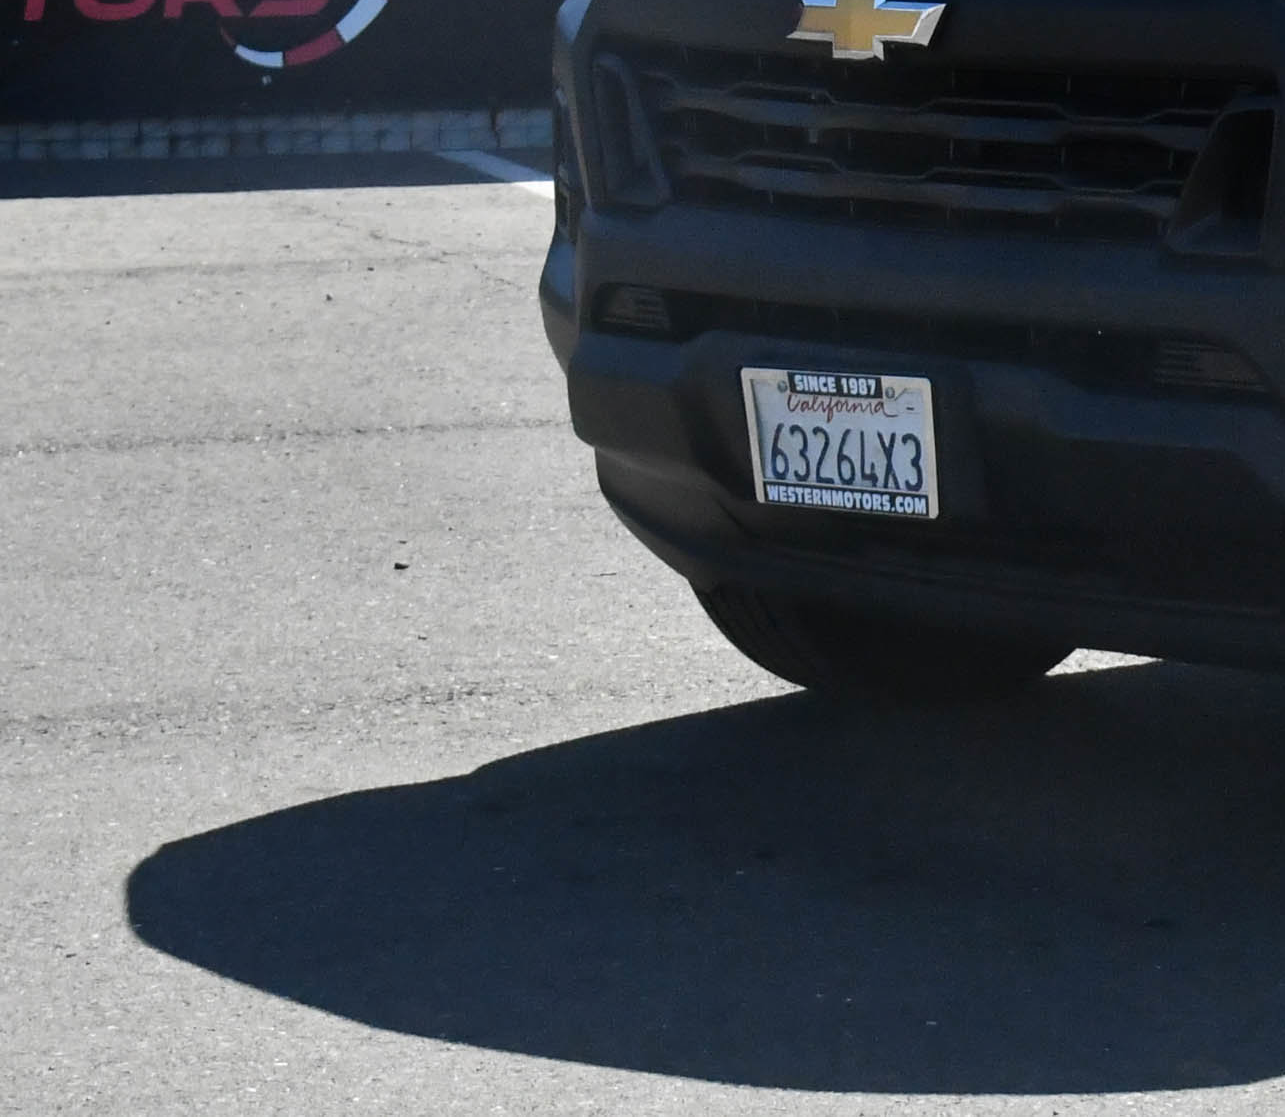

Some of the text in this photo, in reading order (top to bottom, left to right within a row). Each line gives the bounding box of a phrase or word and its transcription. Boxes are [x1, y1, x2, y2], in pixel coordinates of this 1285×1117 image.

[793, 374, 877, 396] SINCE 1987
[787, 394, 898, 424] California
[771, 422, 924, 493] 63264X3
[766, 484, 928, 516] WESTERNMOTORS.COM
